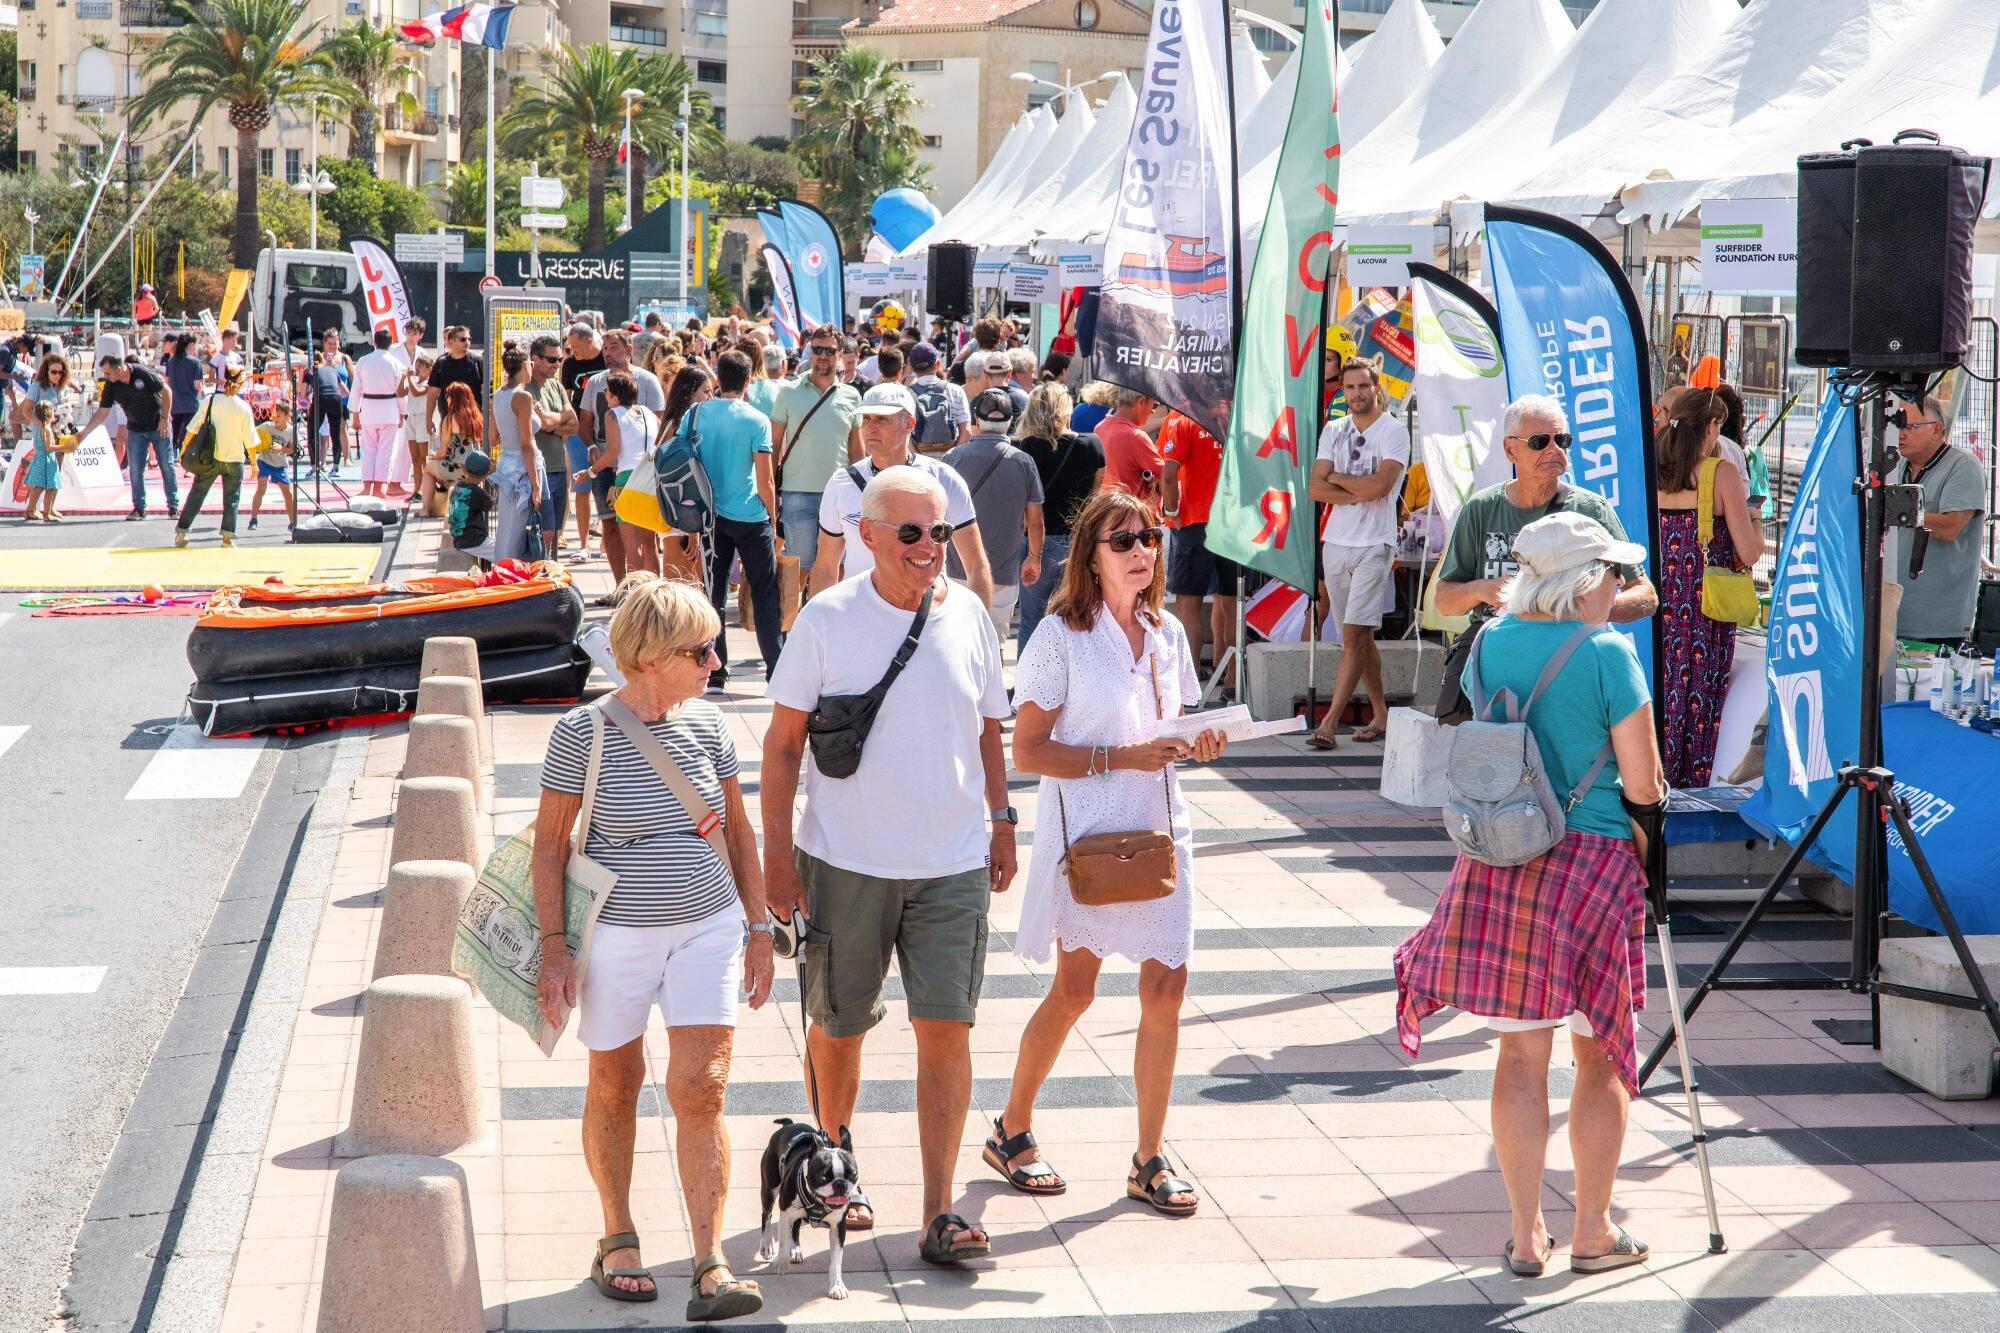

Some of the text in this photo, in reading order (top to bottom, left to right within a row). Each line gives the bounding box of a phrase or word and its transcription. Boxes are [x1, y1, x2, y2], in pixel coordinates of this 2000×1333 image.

[1715, 244, 1762, 252] SURFRIDER
[1715, 254, 1775, 262] FOUNDATION
[545, 258, 624, 280] RESERVE
[640, 311, 696, 323] TWONDO
[75, 457, 99, 466] JUDO
